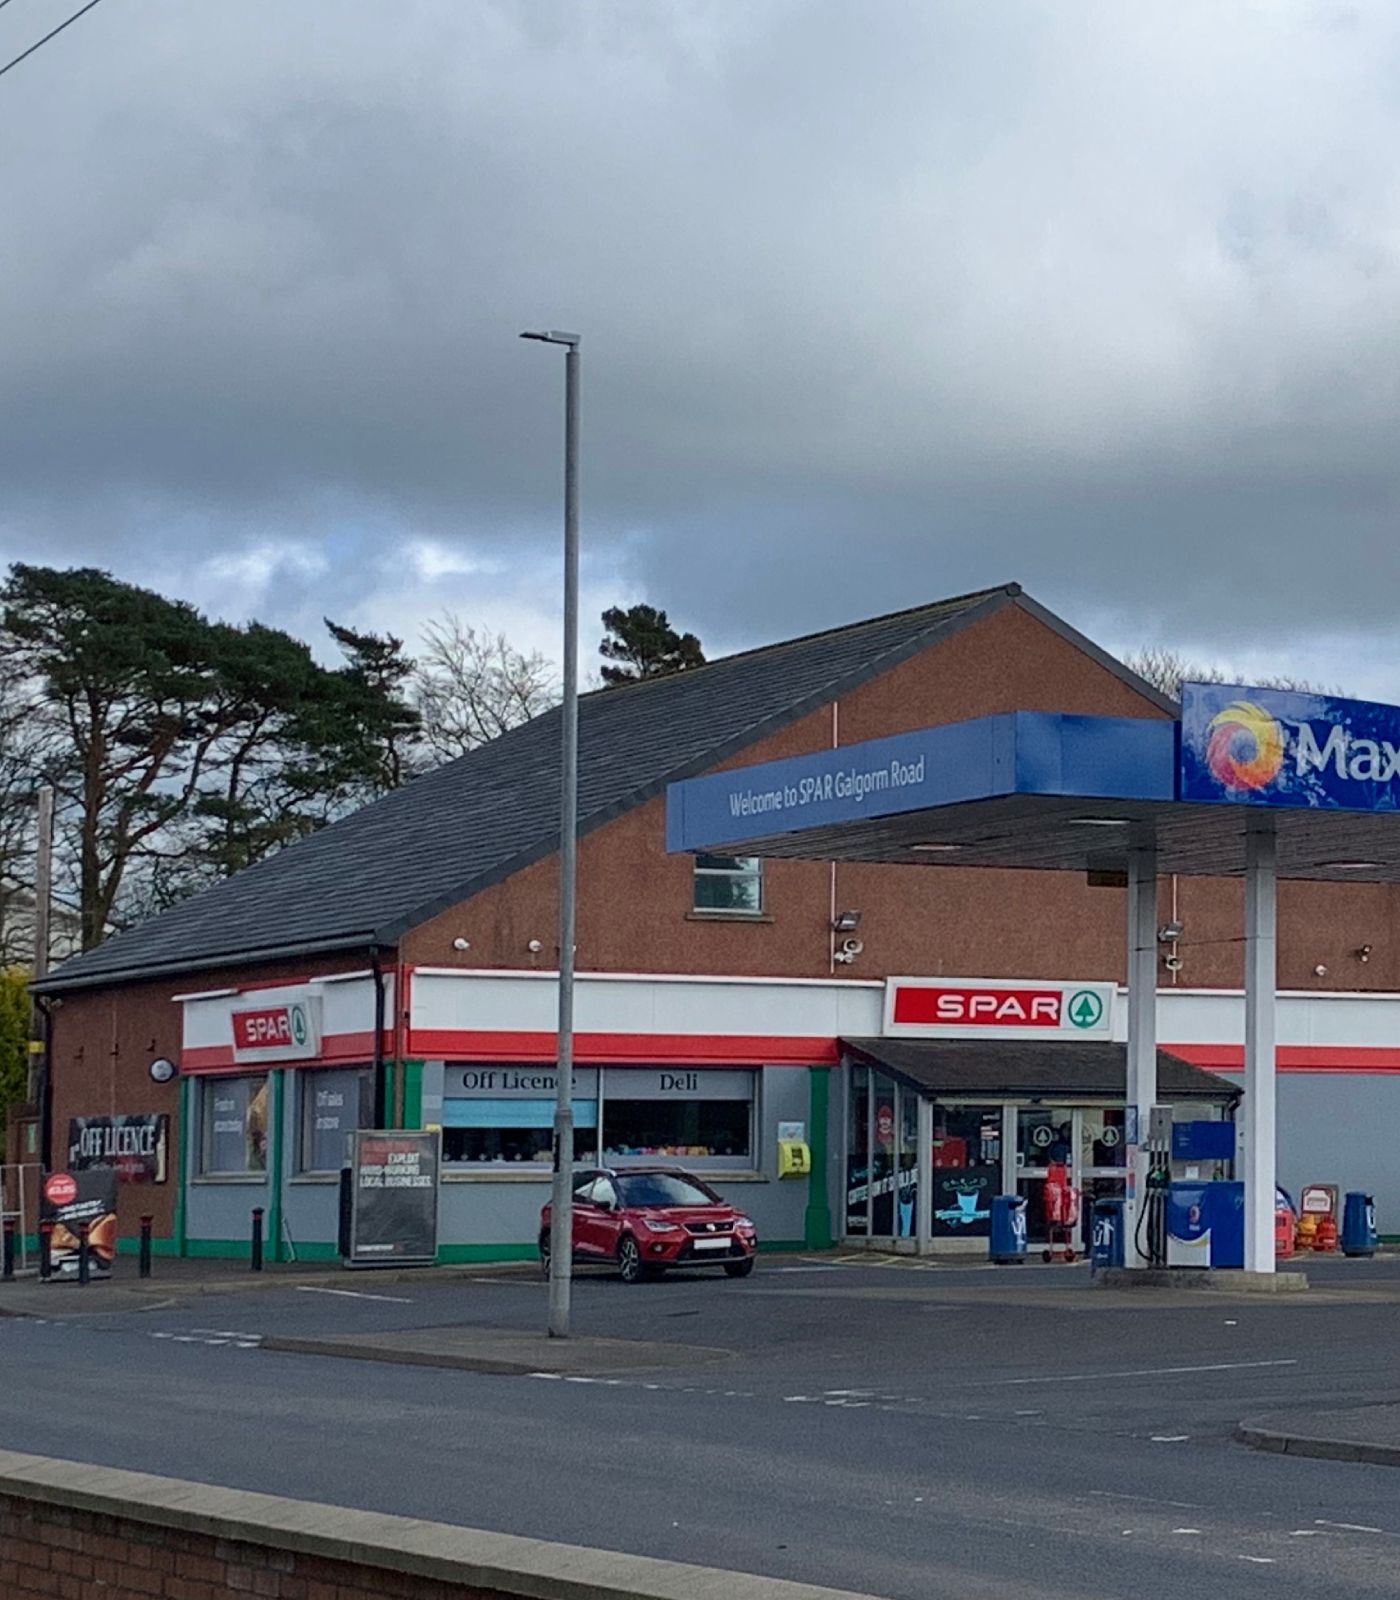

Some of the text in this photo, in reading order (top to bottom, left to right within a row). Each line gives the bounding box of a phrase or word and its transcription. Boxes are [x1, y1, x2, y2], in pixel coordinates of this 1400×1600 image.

[729, 755, 925, 817] Welcome to SPAR Galgorm Road
[936, 994, 1059, 1020] SPAR
[245, 1014, 290, 1042] SPAR
[462, 1071, 577, 1090] Off Licen
[659, 1073, 698, 1091] Deli
[81, 1125, 156, 1157] OFF LICENCE
[387, 1152, 420, 1164] EXPLOIT
[360, 1175, 384, 1188] LOCAL
